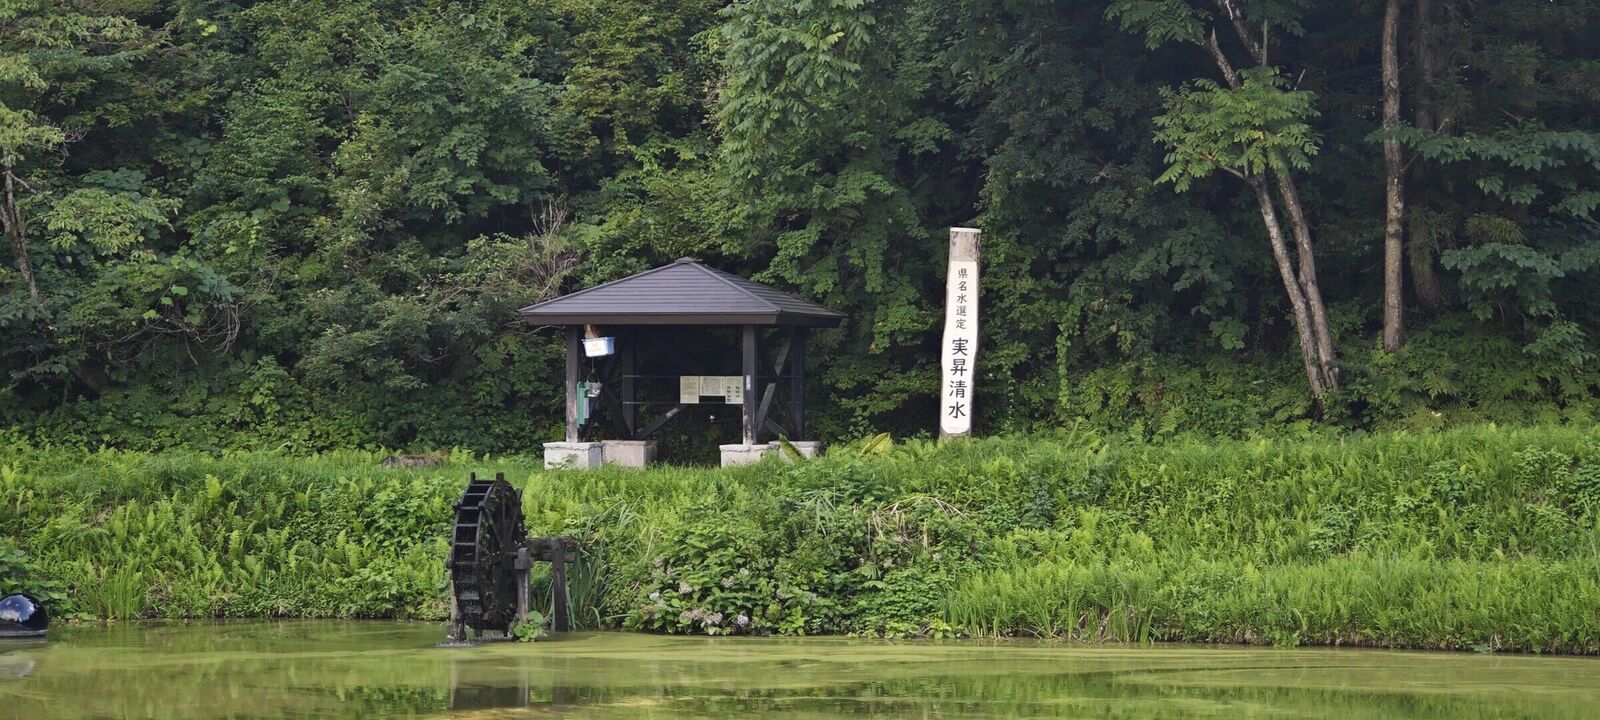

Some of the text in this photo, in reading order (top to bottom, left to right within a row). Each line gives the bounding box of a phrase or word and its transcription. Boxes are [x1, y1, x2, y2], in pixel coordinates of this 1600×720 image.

[956, 268, 969, 330] 県名水選定
[948, 337, 969, 419] 実昇清水
